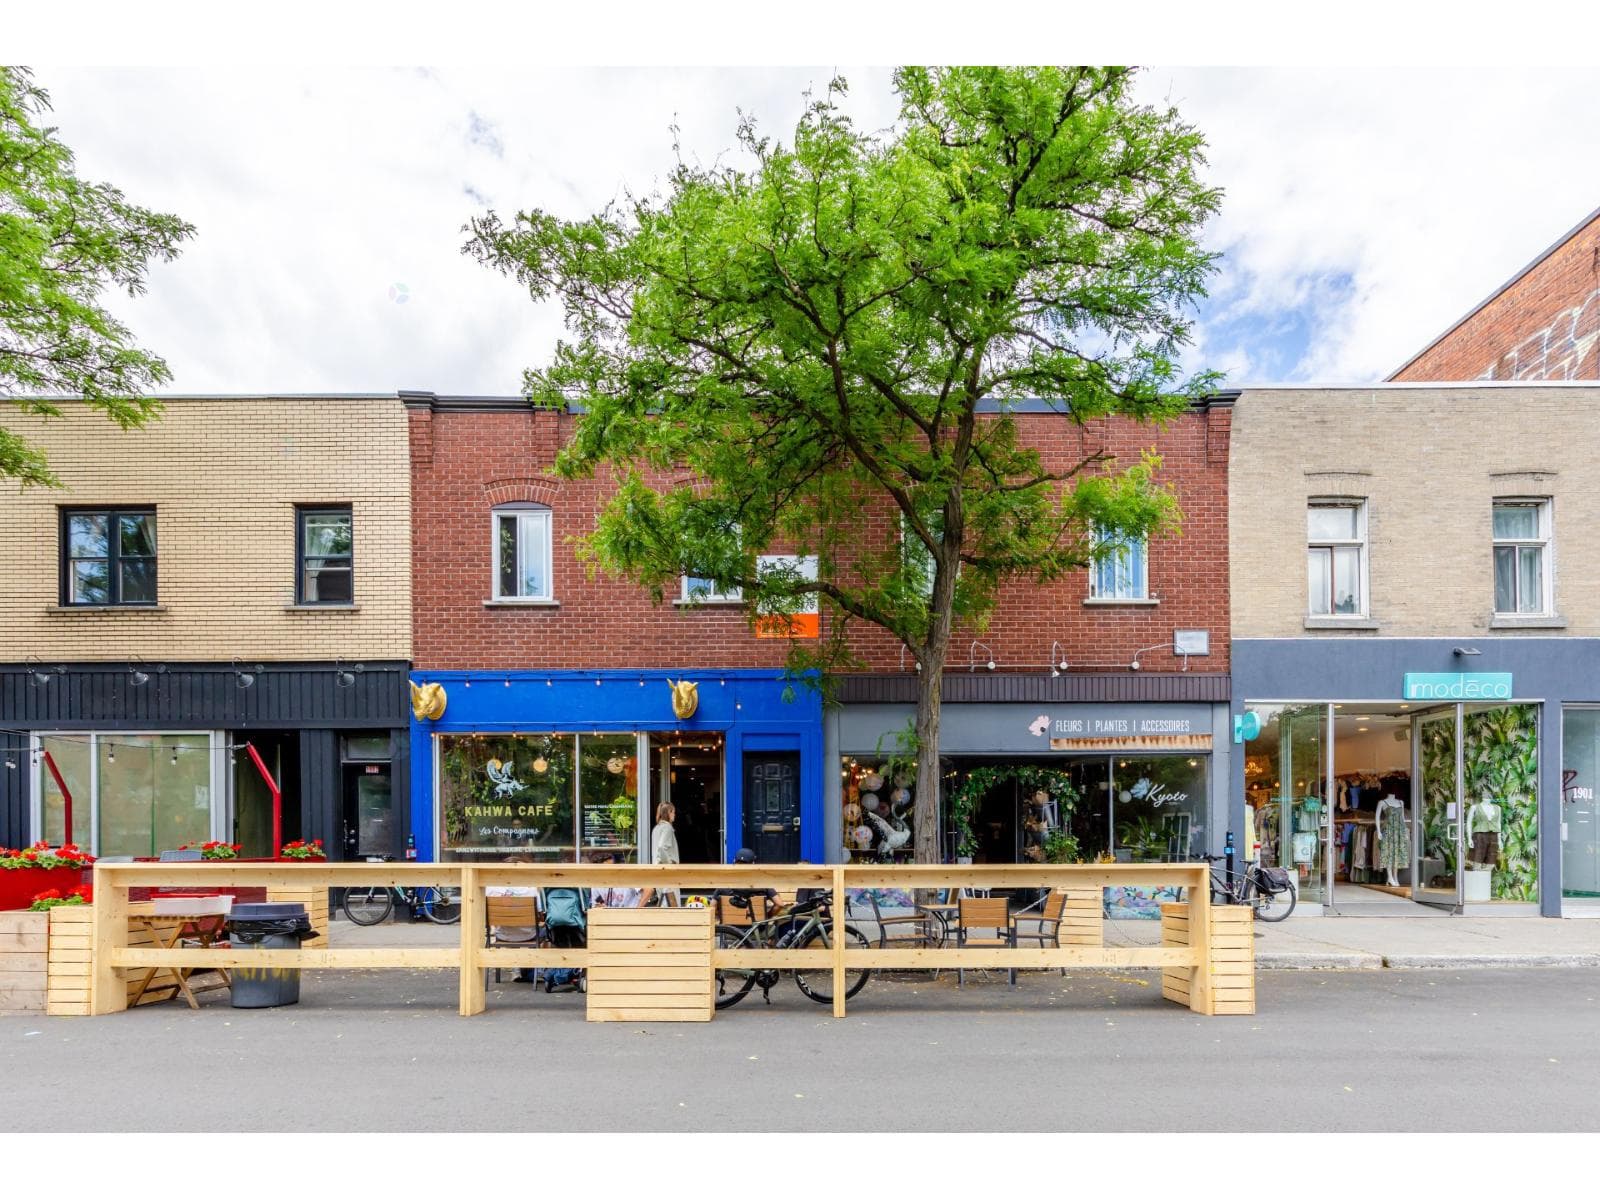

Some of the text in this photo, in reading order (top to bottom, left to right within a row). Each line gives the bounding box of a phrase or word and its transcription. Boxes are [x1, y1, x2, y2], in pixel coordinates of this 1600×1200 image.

[1055, 720, 1190, 732] FLEURS PLANTES ACCESSOIRES
[1145, 783, 1188, 808] Kyoto
[1573, 787, 1593, 800] 1901
[464, 805, 513, 817] KAHWA
